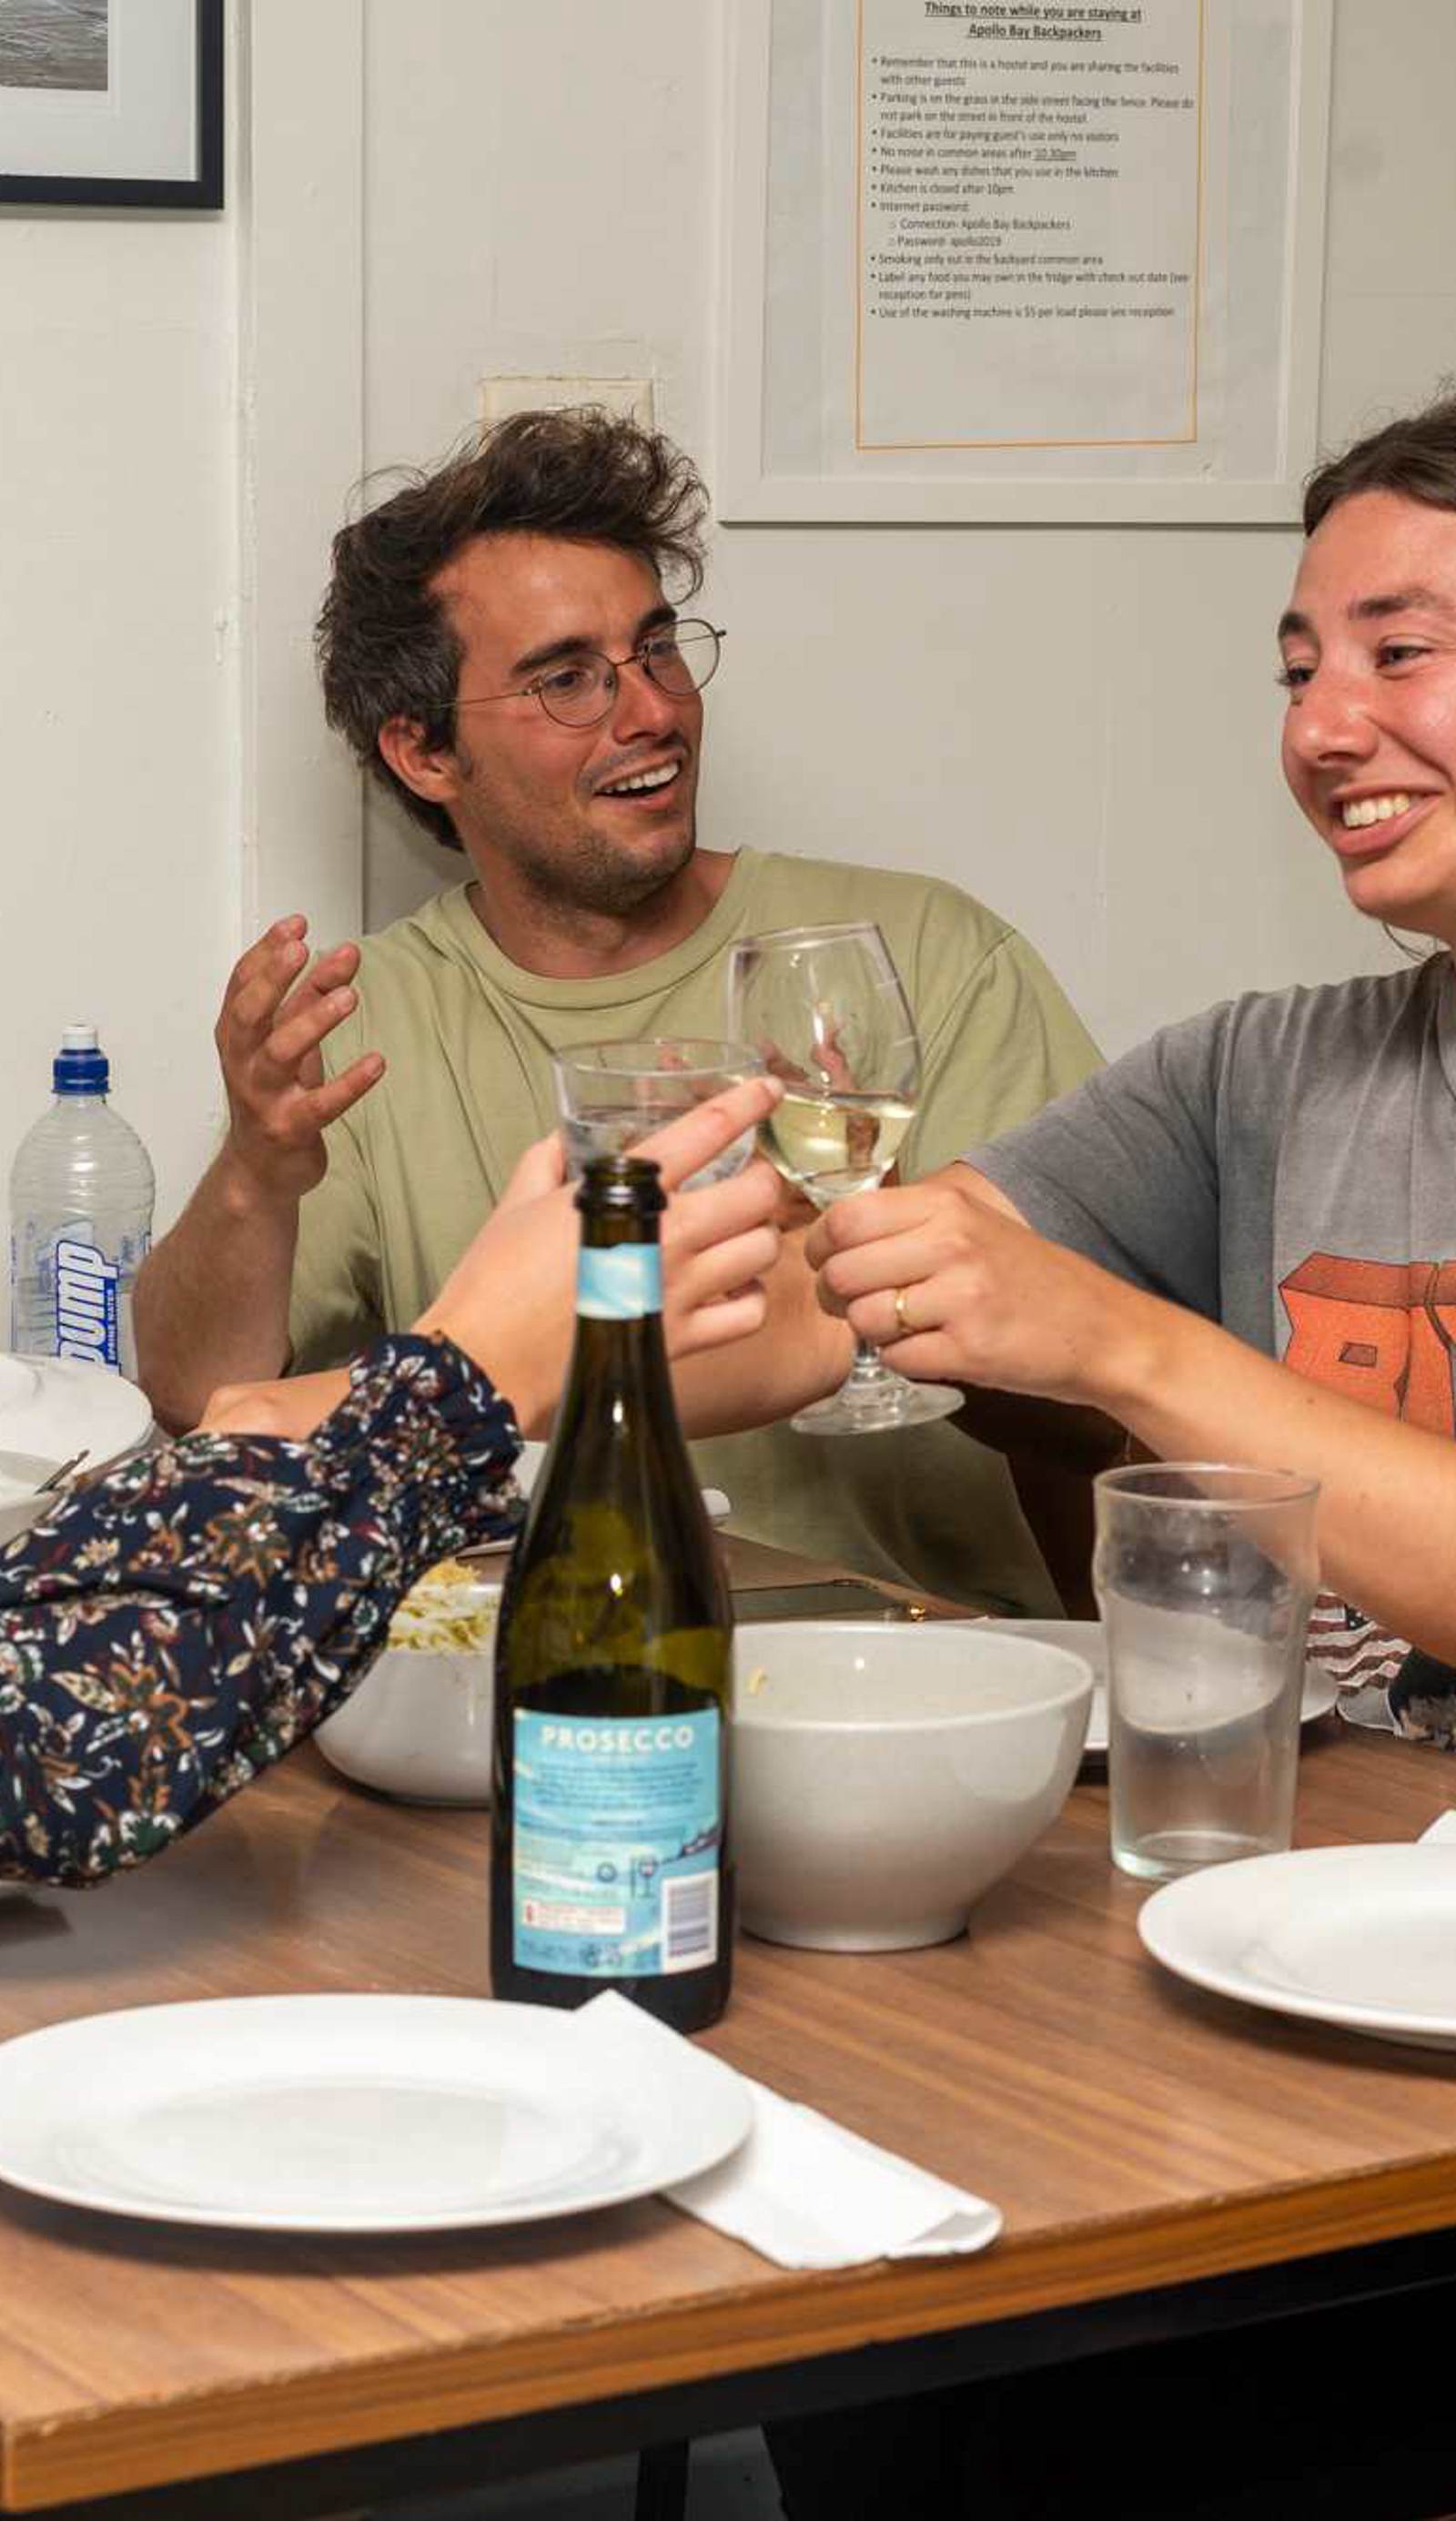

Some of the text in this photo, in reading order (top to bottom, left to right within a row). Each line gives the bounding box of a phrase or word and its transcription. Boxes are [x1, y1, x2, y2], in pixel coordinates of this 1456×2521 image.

[924, 3, 1141, 22] Things to note while you are staying at
[969, 24, 1102, 41] Apollo Bay Backpackers
[880, 56, 934, 67] Remember
[936, 57, 956, 68] that
[959, 58, 976, 69] this
[990, 61, 996, 69] a
[998, 59, 1027, 70] hostel
[1029, 59, 1048, 70] and
[1050, 63, 1067, 74] you
[1070, 63, 1085, 71] are
[1087, 60, 1121, 74] sharing
[1123, 61, 1138, 72] the
[1140, 62, 1179, 73] facilities
[880, 75, 966, 88] with other guests
[880, 92, 917, 106] Parking
[945, 93, 960, 104] the
[963, 96, 987, 107] grass
[1001, 95, 1017, 106] the
[1020, 95, 1039, 106] side
[1042, 95, 1069, 106] street
[1071, 96, 1100, 109] facing
[1102, 96, 1117, 107] the
[1150, 97, 1179, 108] Please
[880, 110, 897, 121] not
[899, 110, 922, 124] park
[939, 111, 956, 122] the
[957, 111, 986, 122] street
[999, 112, 1022, 123] front
[1039, 112, 1054, 123] the
[1056, 113, 1087, 124] hostel
[880, 127, 924, 138] Facilities
[925, 131, 940, 139] are
[943, 128, 956, 139] for
[959, 129, 989, 143] paying
[1028, 133, 1046, 141] use
[1047, 130, 1067, 144] only
[1087, 131, 1120, 142] visitors
[897, 147, 924, 157] noise
[1010, 147, 1032, 157] after
[880, 165, 911, 175] Please
[915, 166, 939, 176] wash
[942, 168, 958, 178] any
[961, 166, 989, 176] dishes
[991, 167, 1012, 177] that
[1015, 169, 1033, 179] you
[1065, 167, 1082, 177] the
[1084, 167, 1119, 177] kitchen
[880, 183, 918, 194] Kitchen
[929, 183, 960, 194] closed
[962, 183, 986, 194] after
[988, 183, 1015, 197] 10pm
[879, 201, 920, 211] Internet
[961, 218, 991, 231] Apollo
[993, 218, 1010, 231] Bay
[1013, 218, 1071, 231] Backpackers
[878, 253, 922, 267] Smoking
[924, 253, 945, 267] only
[946, 253, 963, 264] out
[976, 254, 991, 265] the
[994, 254, 1036, 268] backyard
[1037, 257, 1079, 265] common
[1082, 257, 1104, 265] area
[879, 272, 906, 282] Label
[908, 275, 925, 285] any
[927, 272, 951, 282] food
[953, 275, 970, 285] you
[972, 275, 991, 285] may
[1027, 273, 1043, 283] the
[1045, 273, 1073, 286] fridge
[1076, 273, 1095, 283] with
[1097, 273, 1125, 283] check
[1127, 273, 1145, 283] out
[1148, 273, 1168, 283] date
[879, 289, 925, 302] reception
[928, 289, 943, 299] for
[879, 307, 896, 317] Use
[913, 307, 928, 317] the
[931, 307, 970, 319] washing
[973, 307, 1012, 317] machine
[1037, 310, 1053, 320] per
[1056, 308, 1077, 318] load
[1078, 308, 1108, 320] please
[1127, 308, 1174, 320] reception
[56, 1240, 119, 1363] pump
[541, 1725, 694, 1753] PROSECCO
